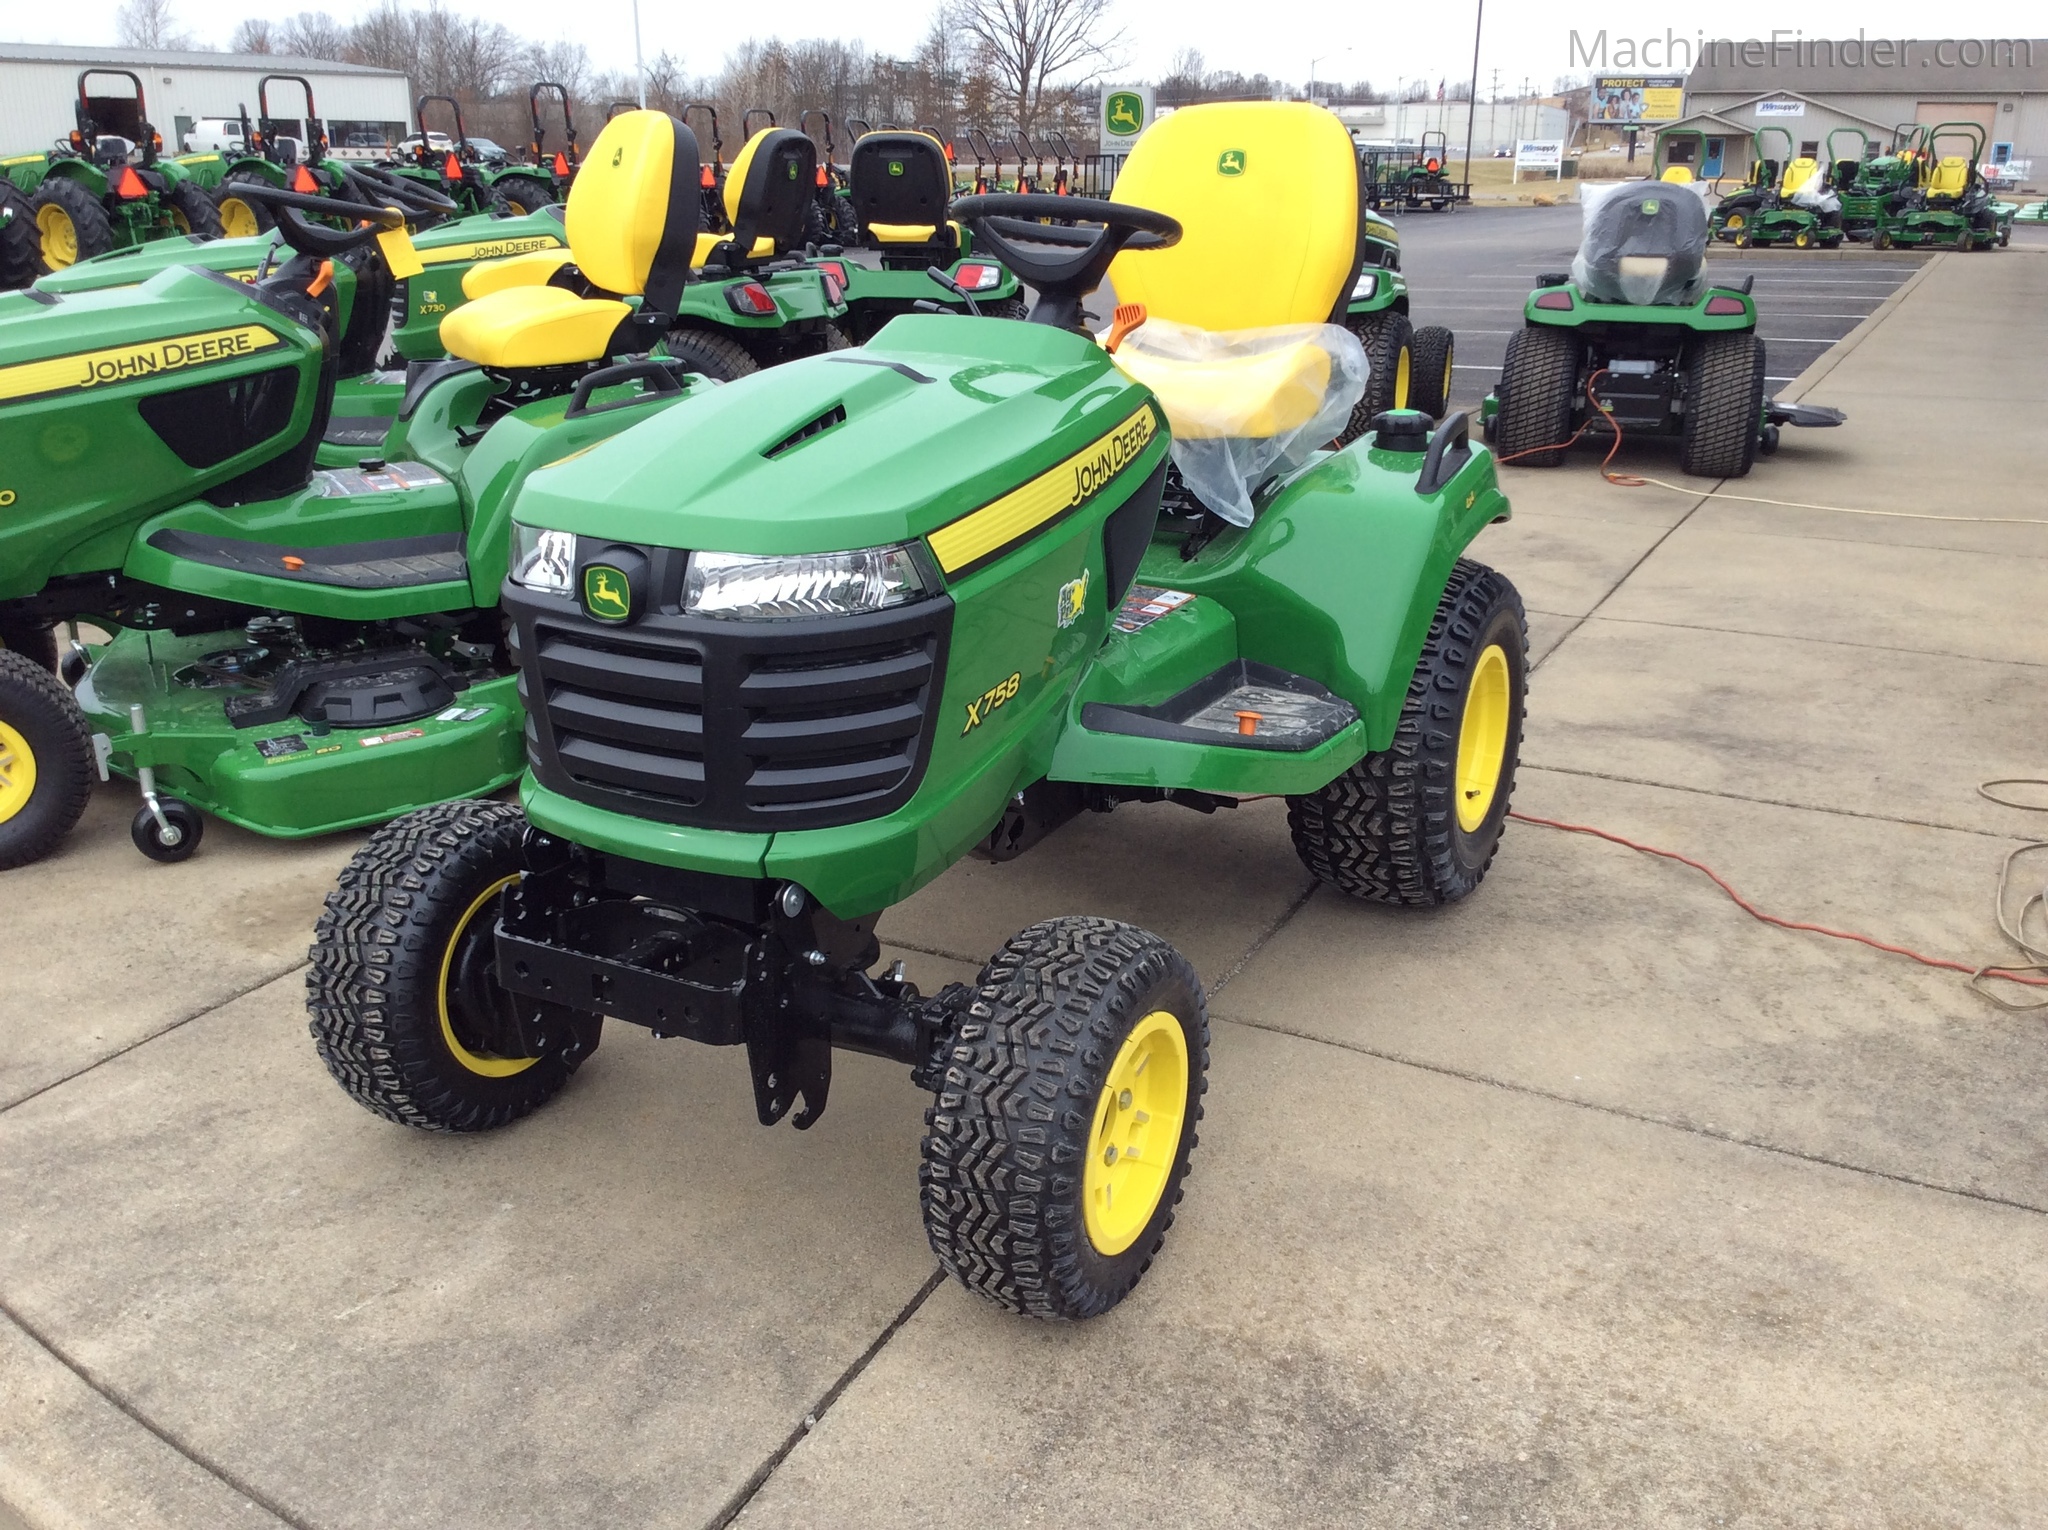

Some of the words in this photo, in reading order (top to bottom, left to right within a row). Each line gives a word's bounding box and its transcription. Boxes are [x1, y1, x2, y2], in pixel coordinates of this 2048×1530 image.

[1602, 79, 1645, 87] PROTECT
[1760, 103, 1801, 112] Winsupply
[1521, 144, 1558, 153] Winsupply
[471, 246, 503, 260] JOHN
[505, 239, 547, 254] DEERE
[420, 303, 446, 315] X730
[80, 352, 158, 385] JOHN
[162, 333, 252, 367] DEERE
[1071, 448, 1113, 504] JOHN
[1111, 414, 1149, 469] DEERE
[960, 671, 1021, 738] X758
